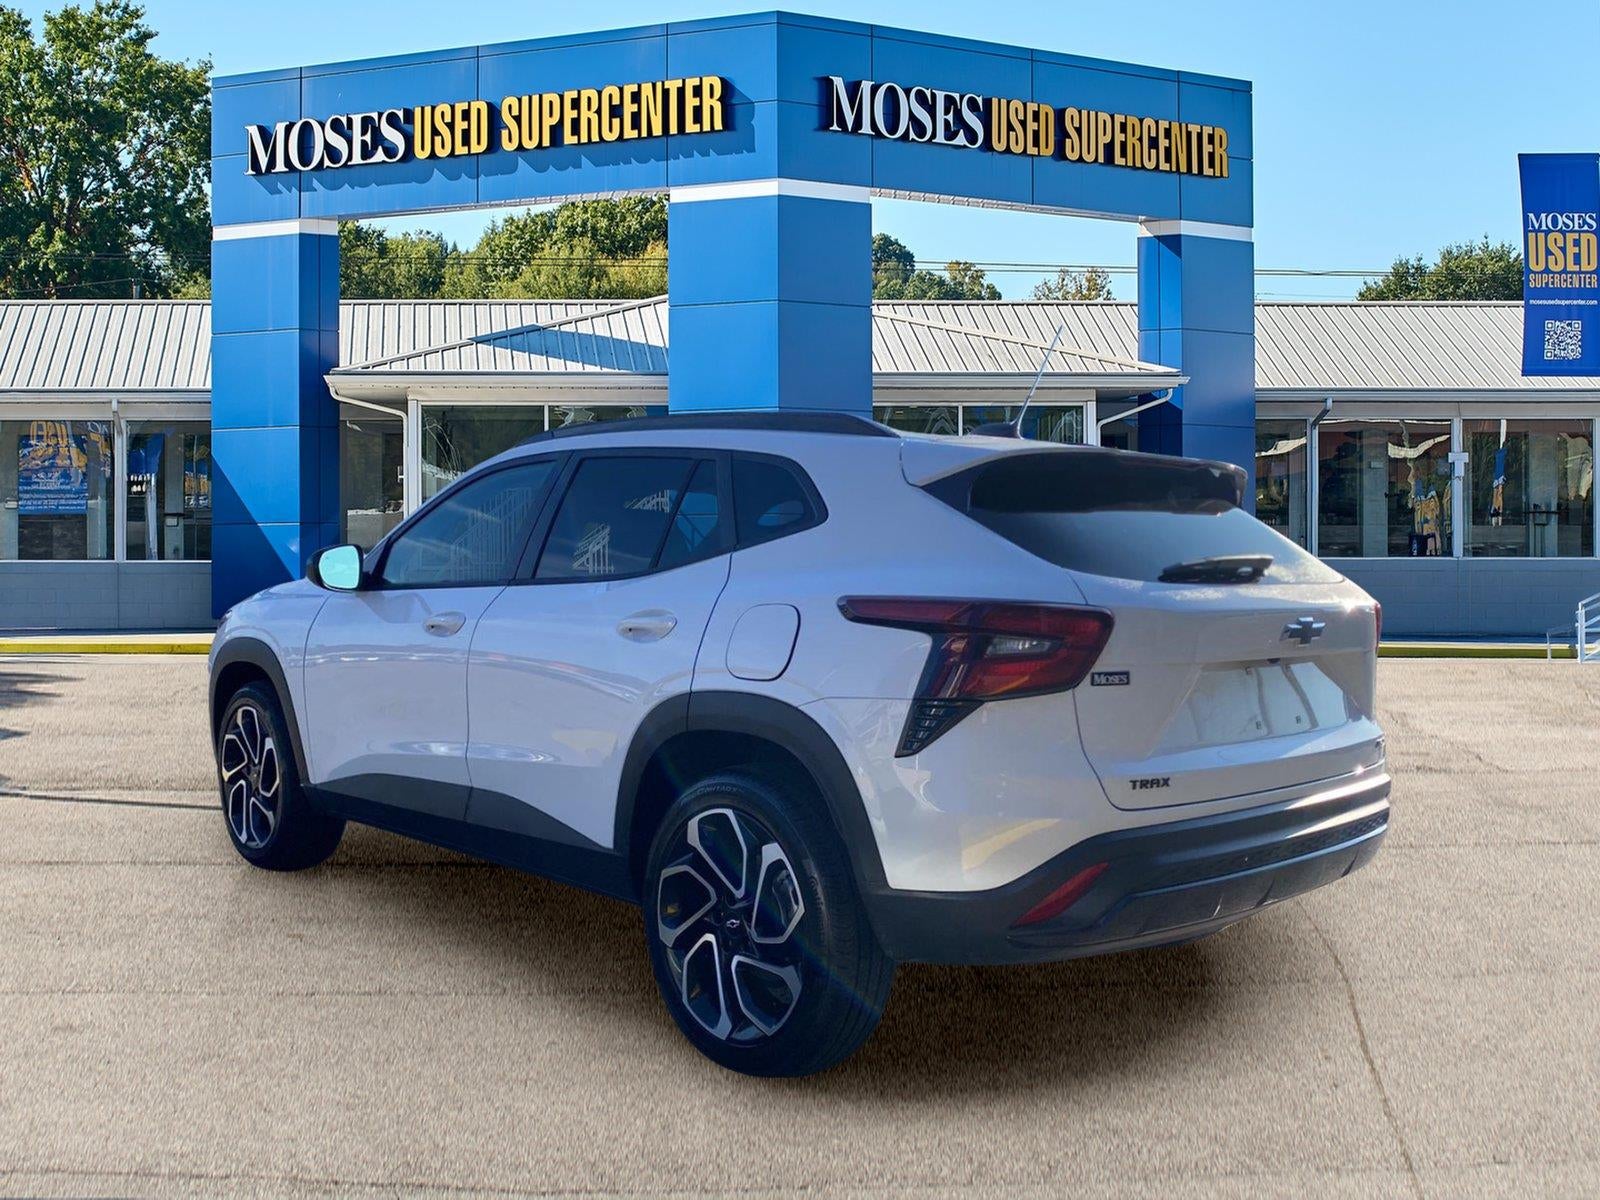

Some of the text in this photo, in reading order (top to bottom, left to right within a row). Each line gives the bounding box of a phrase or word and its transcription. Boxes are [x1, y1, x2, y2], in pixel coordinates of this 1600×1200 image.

[245, 75, 724, 175] MOSES USED SUPERCENTER
[828, 75, 1229, 178] MOSES USED SUPERCENTER
[1527, 212, 1597, 231] MOSES
[1528, 232, 1598, 272] USED
[1529, 273, 1598, 288] SUPERCENTER
[1129, 777, 1170, 790] TRAX
